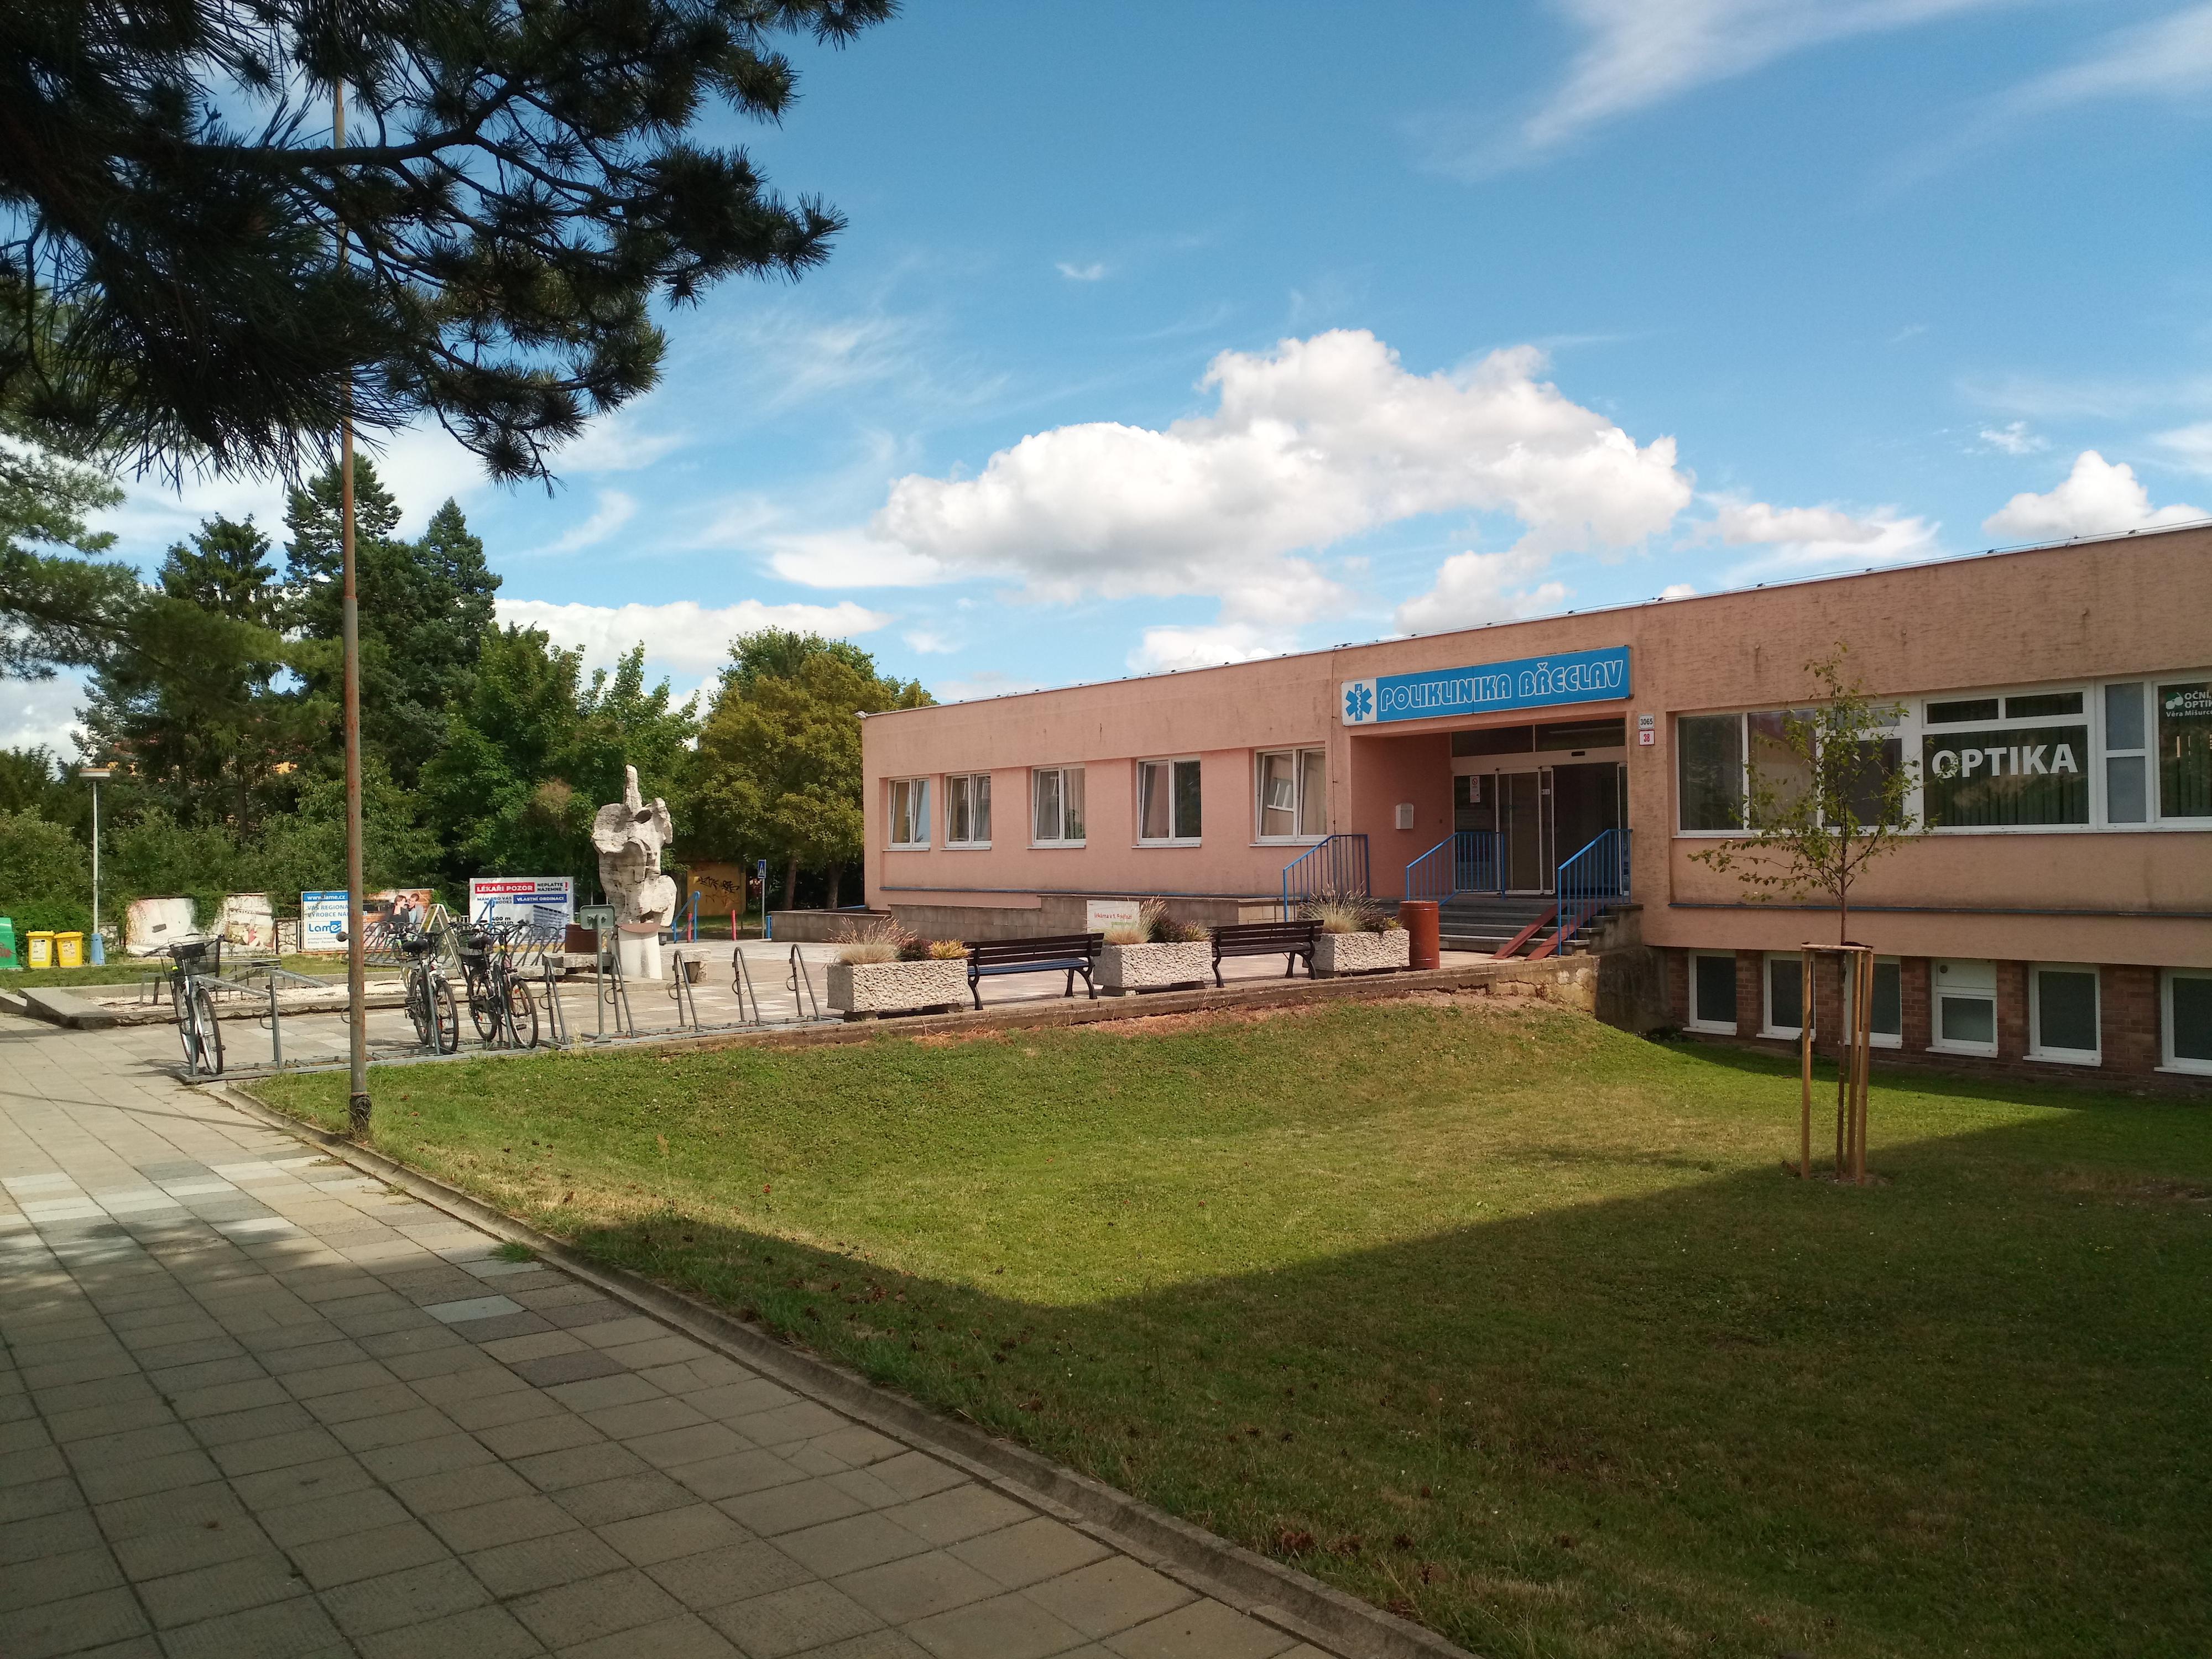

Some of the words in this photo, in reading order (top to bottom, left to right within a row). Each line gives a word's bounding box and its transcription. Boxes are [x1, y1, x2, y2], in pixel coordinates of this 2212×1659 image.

[1380, 674, 1511, 712] POLIKLINIKA
[1519, 660, 1624, 698] BŘECLAV
[1644, 733, 1650, 742] 38
[1932, 743, 2078, 779] OPTIKA
